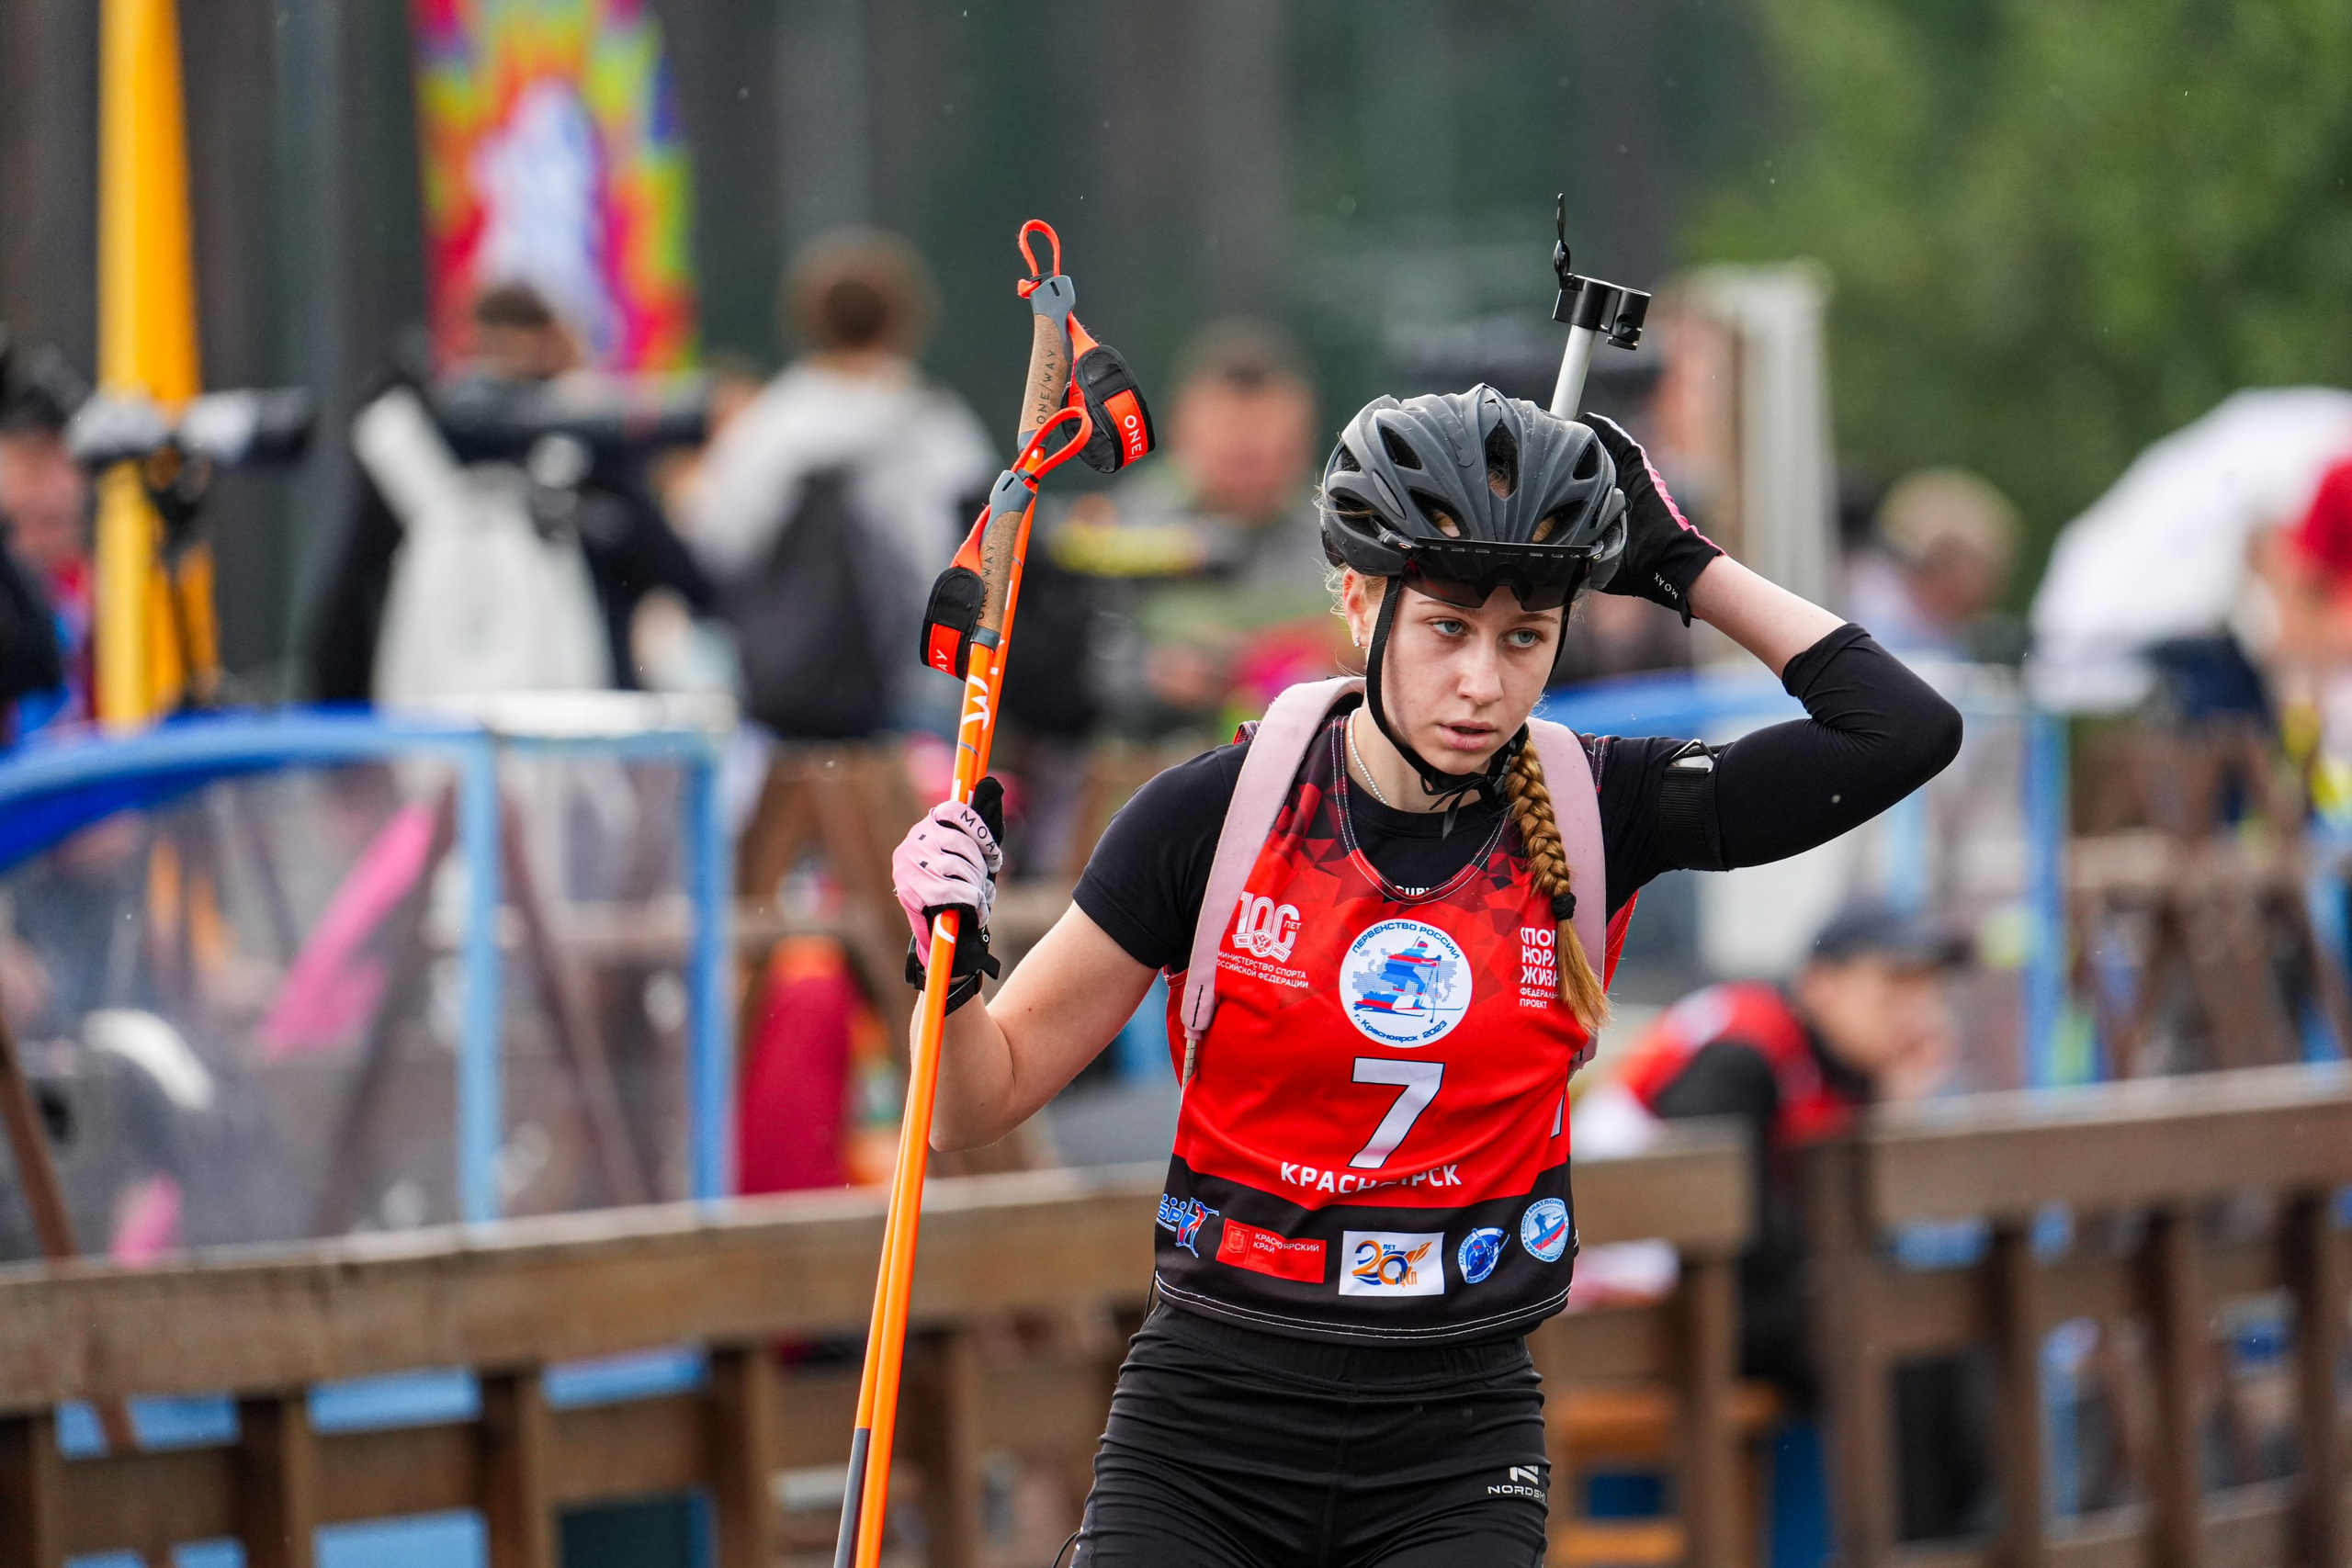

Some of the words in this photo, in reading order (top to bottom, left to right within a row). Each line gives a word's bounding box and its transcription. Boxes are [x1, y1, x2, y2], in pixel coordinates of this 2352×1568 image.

[1124, 413, 1144, 461] ONE/
[1654, 572, 1679, 600] MOAX
[1283, 920, 1302, 930] ЛЕТ
[1351, 921, 1418, 953] ПЕРВЕНСТВО
[1419, 926, 1461, 959] РОССИИ
[1216, 959, 1257, 977] ОССИЙСКОЙ
[1258, 972, 1309, 988] ФЕДЕРАЦИИ
[1218, 950, 1274, 972] МИНИСТЕРСТВО
[1275, 966, 1306, 979] СПОРТА
[1520, 998, 1547, 1009] ПРОЕКТ
[1361, 1019, 1419, 1043] Красноярск
[1422, 1020, 1448, 1039] 2023
[1348, 1056, 1445, 1169] 7
[1252, 1240, 1275, 1254] КРАЙ
[1255, 1232, 1320, 1252] КРАСНОЯРСКИЙ
[1351, 1239, 1408, 1286] 20
